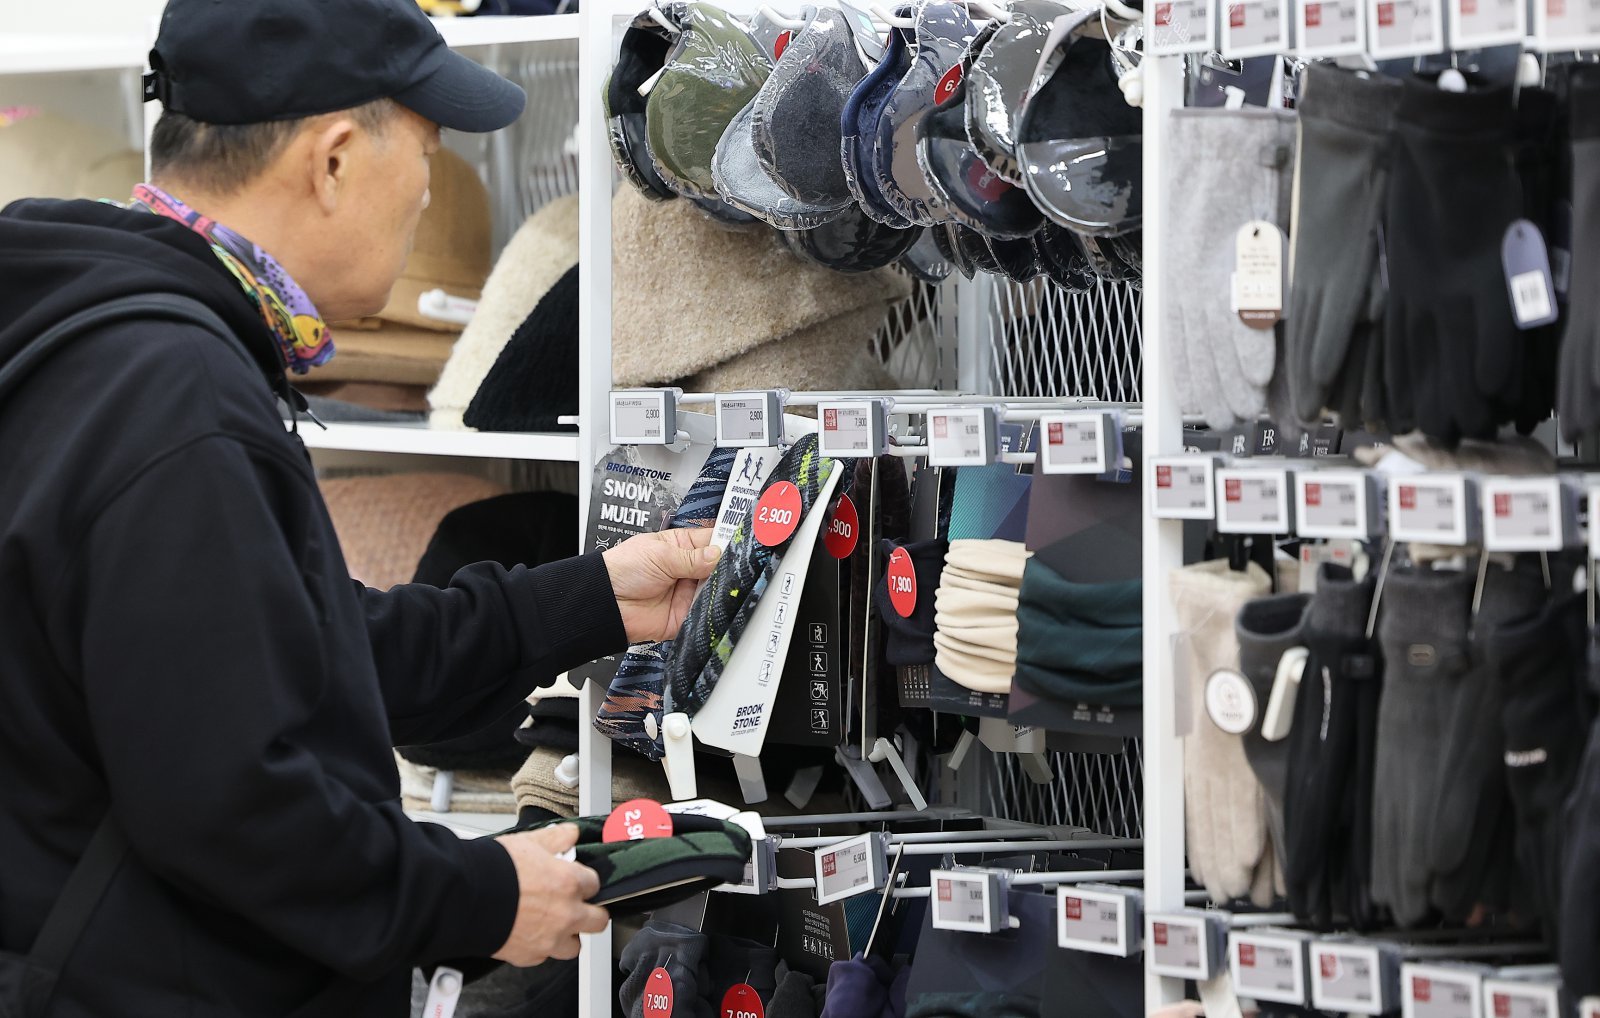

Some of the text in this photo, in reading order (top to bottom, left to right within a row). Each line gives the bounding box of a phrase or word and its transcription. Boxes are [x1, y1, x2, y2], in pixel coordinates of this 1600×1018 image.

[646, 409, 660, 420] 2,900
[750, 410, 763, 422] 2,900
[606, 462, 672, 481] BROOKSTONE
[603, 478, 653, 503] SNOW
[758, 506, 793, 525] 2,900
[829, 518, 852, 538] ,900
[891, 575, 912, 593] 7,900
[736, 703, 764, 718] BROOK
[732, 716, 761, 730] STONE
[853, 851, 867, 864] 6,900
[647, 993, 668, 1011] 7,900
